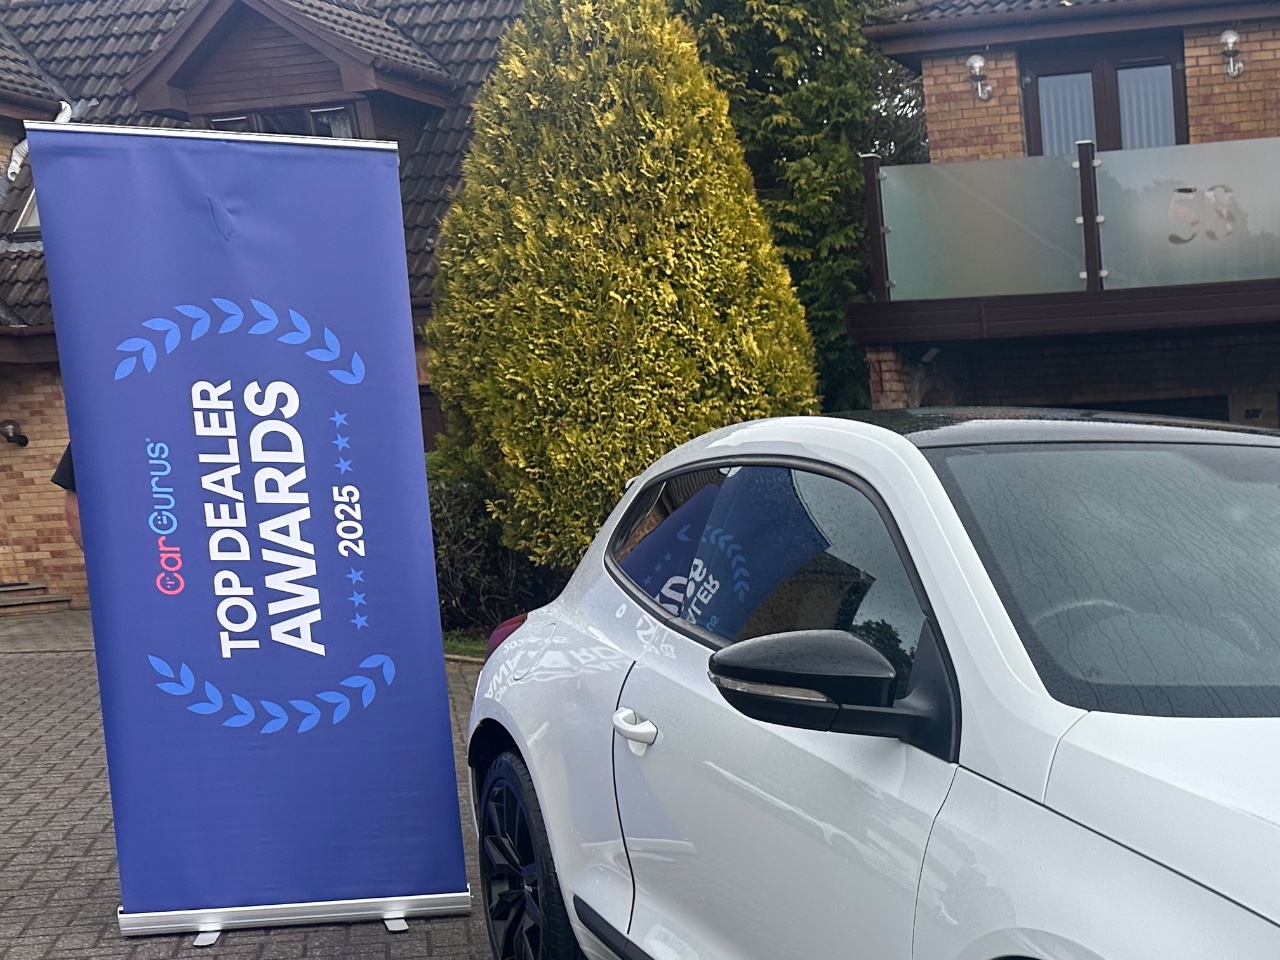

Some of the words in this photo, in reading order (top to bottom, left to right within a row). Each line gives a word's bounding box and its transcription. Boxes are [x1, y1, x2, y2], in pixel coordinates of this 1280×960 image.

[146, 442, 185, 596] CarGurus
[191, 379, 251, 561] DEALER
[243, 380, 326, 657] AWARDS
[332, 485, 366, 557] 2025
[213, 569, 260, 659] TOP
